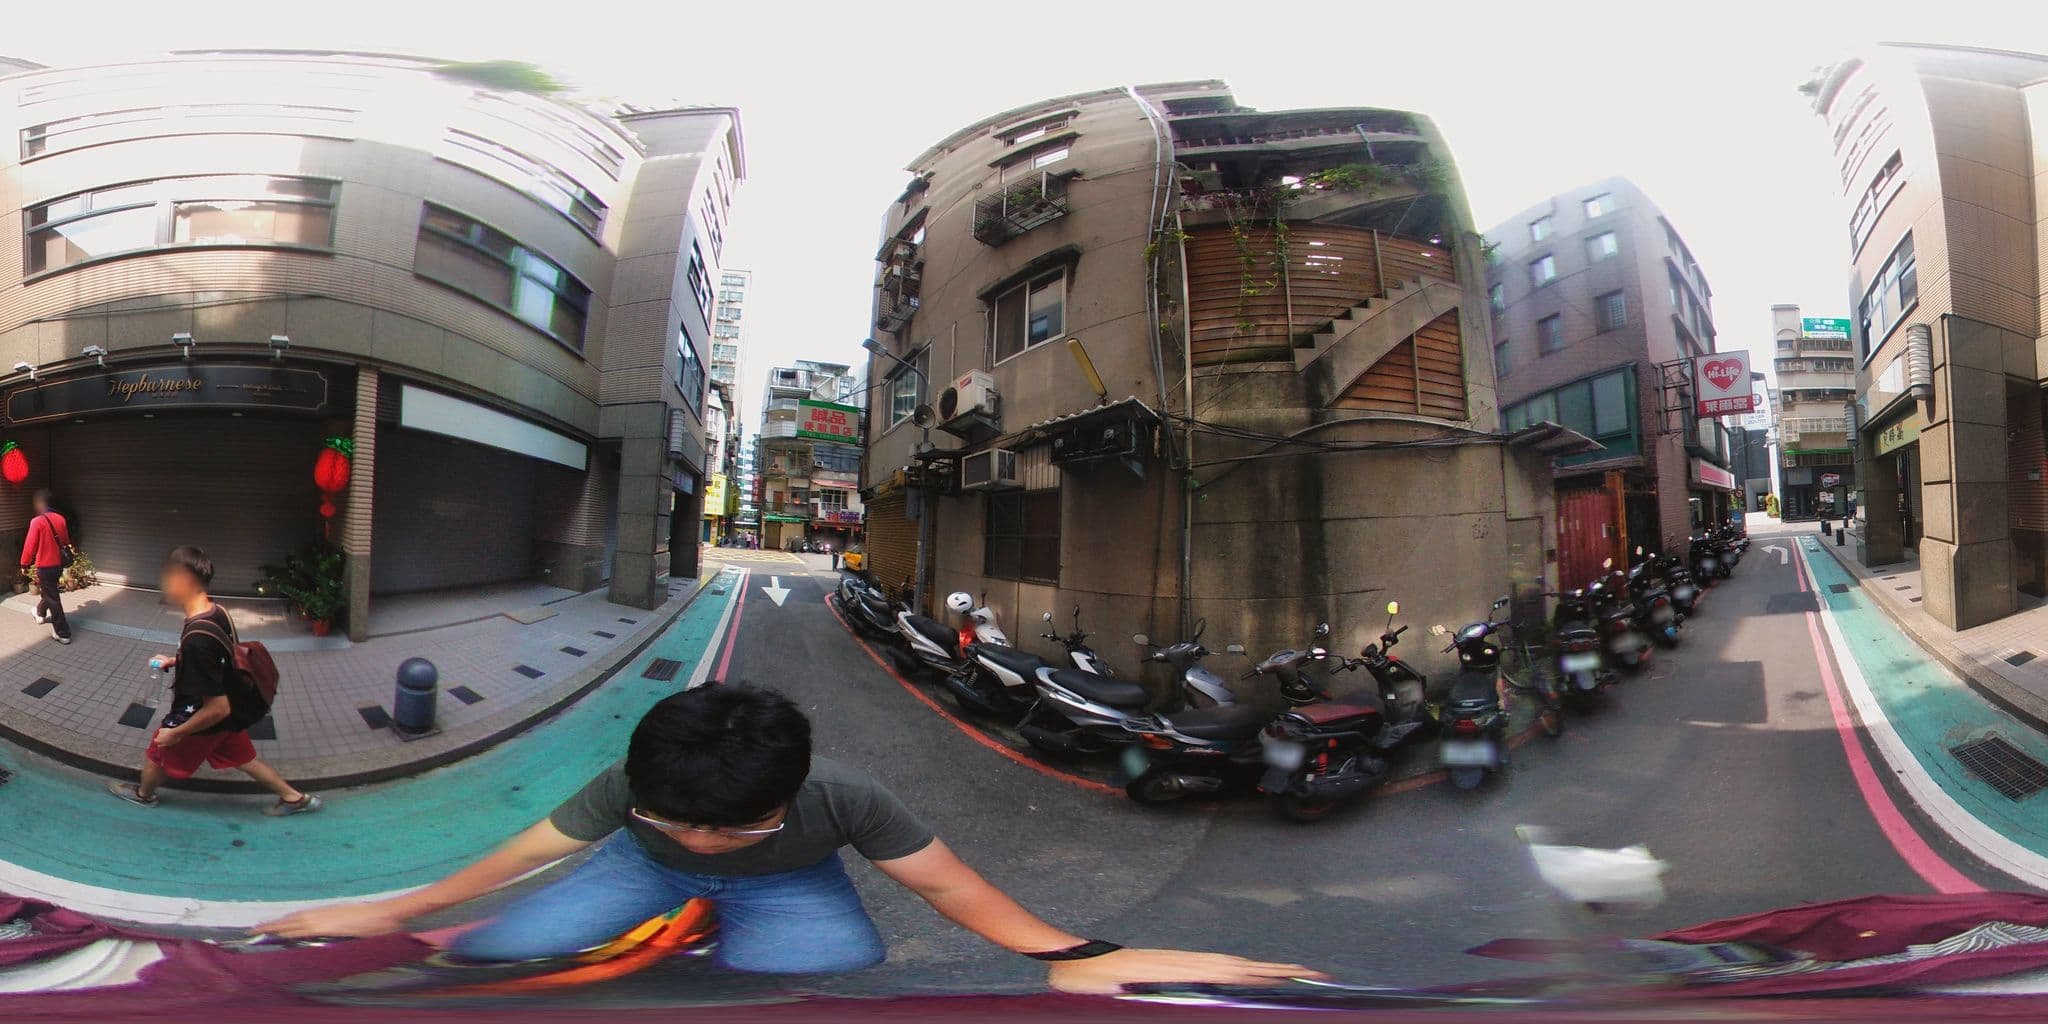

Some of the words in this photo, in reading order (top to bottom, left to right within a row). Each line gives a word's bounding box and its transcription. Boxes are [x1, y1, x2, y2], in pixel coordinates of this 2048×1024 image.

[1707, 366, 1740, 381] Hi-Life
[108, 373, 202, 401] Hepburnese
[1705, 398, 1747, 413] 萊爾富
[811, 408, 846, 425] 誠品
